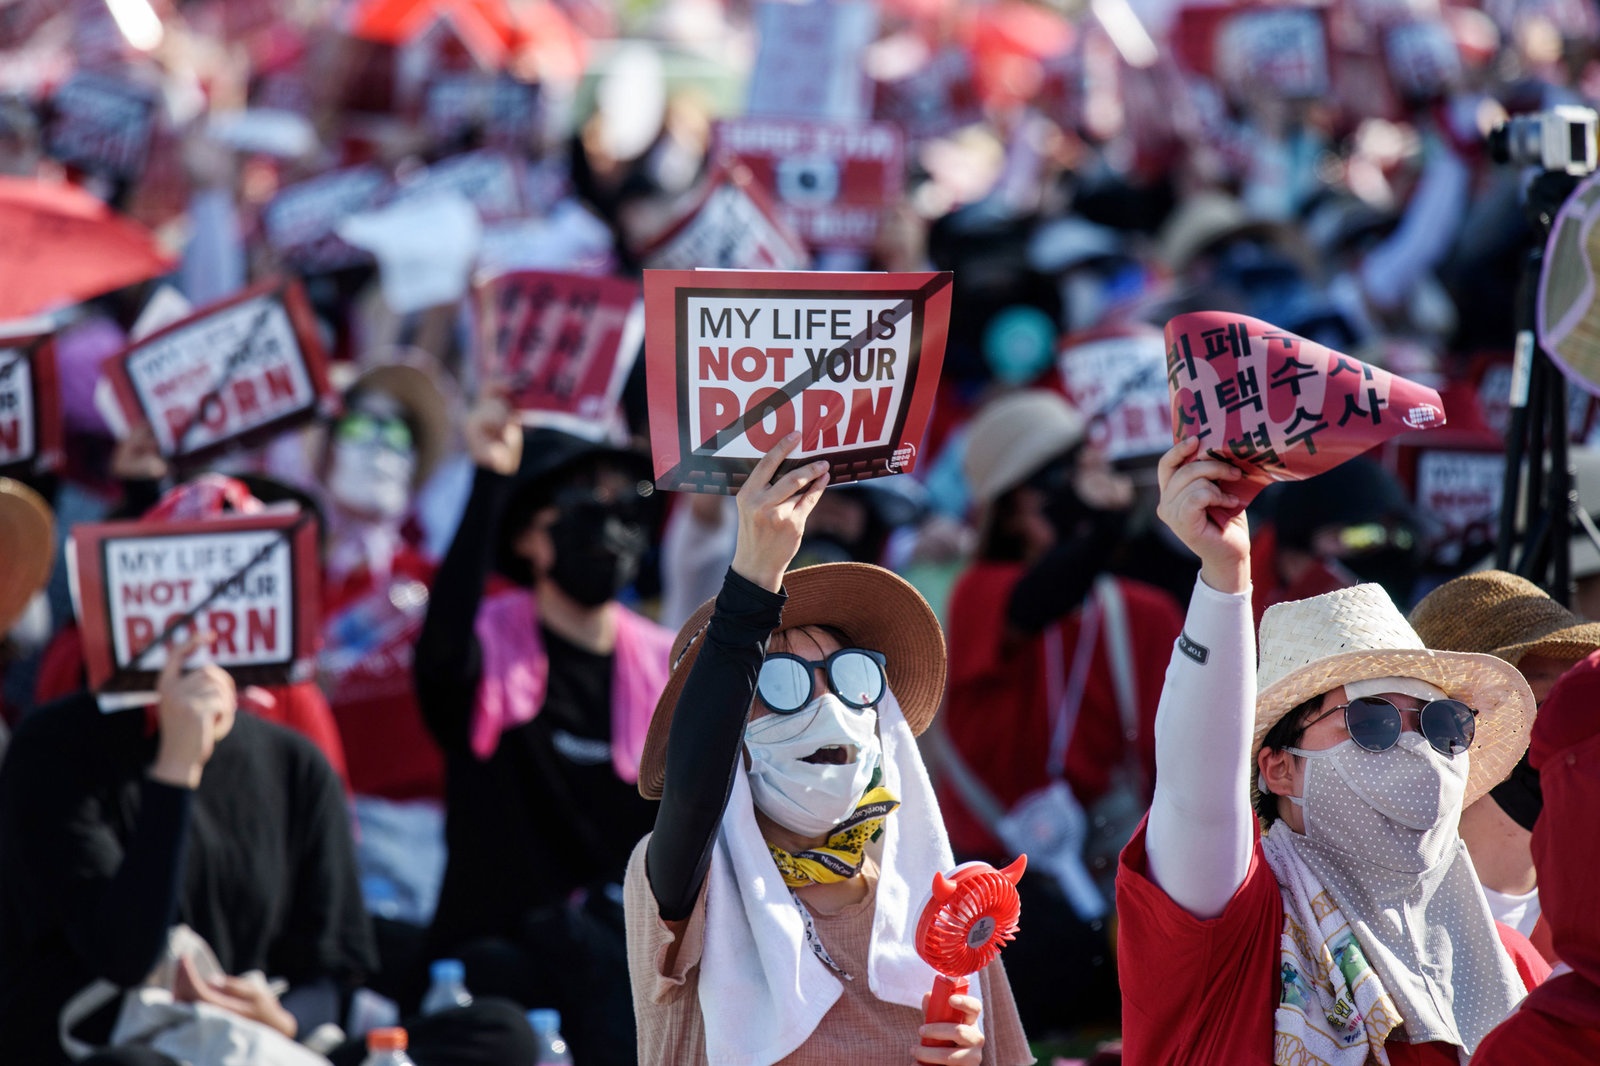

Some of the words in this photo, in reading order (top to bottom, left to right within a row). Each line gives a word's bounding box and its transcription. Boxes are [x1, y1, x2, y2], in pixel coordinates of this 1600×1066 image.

[700, 307, 761, 339] MY
[772, 308, 852, 341] LIFE
[866, 308, 897, 341] IS
[698, 346, 794, 383] NOT
[804, 347, 897, 384] YOUR
[164, 364, 297, 447] PORN
[698, 385, 894, 454] PORN
[1206, 387, 1386, 477] 별수사
[118, 553, 168, 573] MY
[121, 579, 194, 606] NOT
[124, 607, 277, 659] PORN
